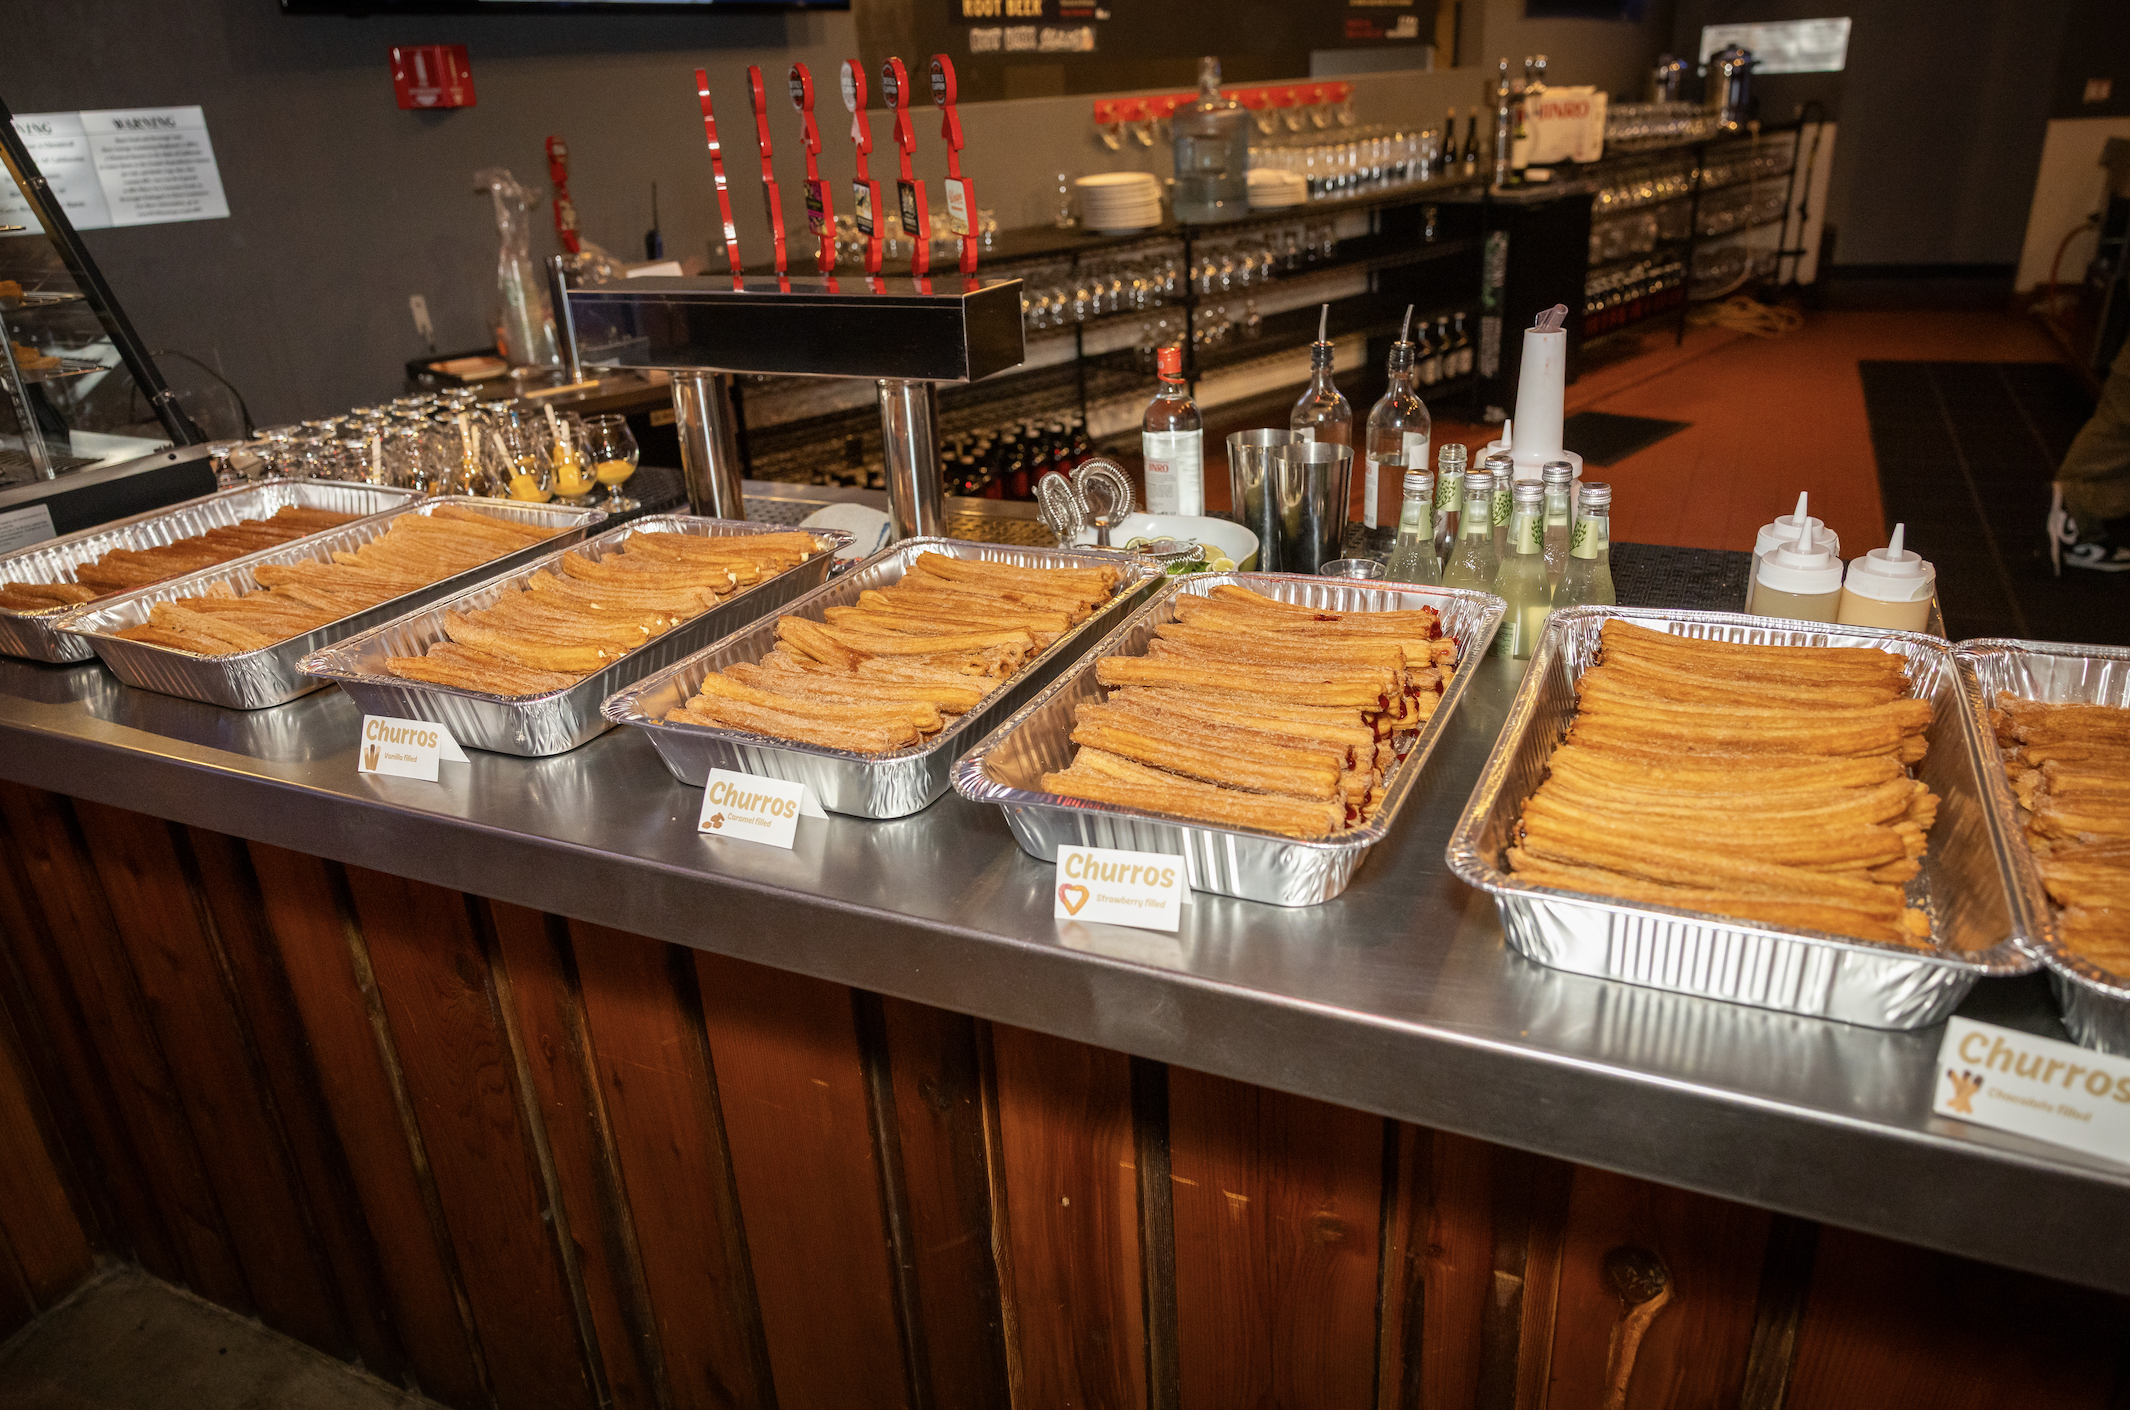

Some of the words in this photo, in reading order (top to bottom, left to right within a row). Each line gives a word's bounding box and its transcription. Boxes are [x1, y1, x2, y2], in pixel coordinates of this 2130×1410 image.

[112, 115, 176, 130] WARNING
[366, 719, 438, 748] Churros
[384, 752, 403, 761] Vanilla
[403, 754, 418, 763] filled
[709, 781, 797, 819] Churros
[727, 812, 755, 825] Caramel
[755, 817, 772, 828] filled
[1065, 852, 1176, 889] Churros
[1096, 893, 1143, 908] Strawberry
[1144, 898, 1166, 909] filled
